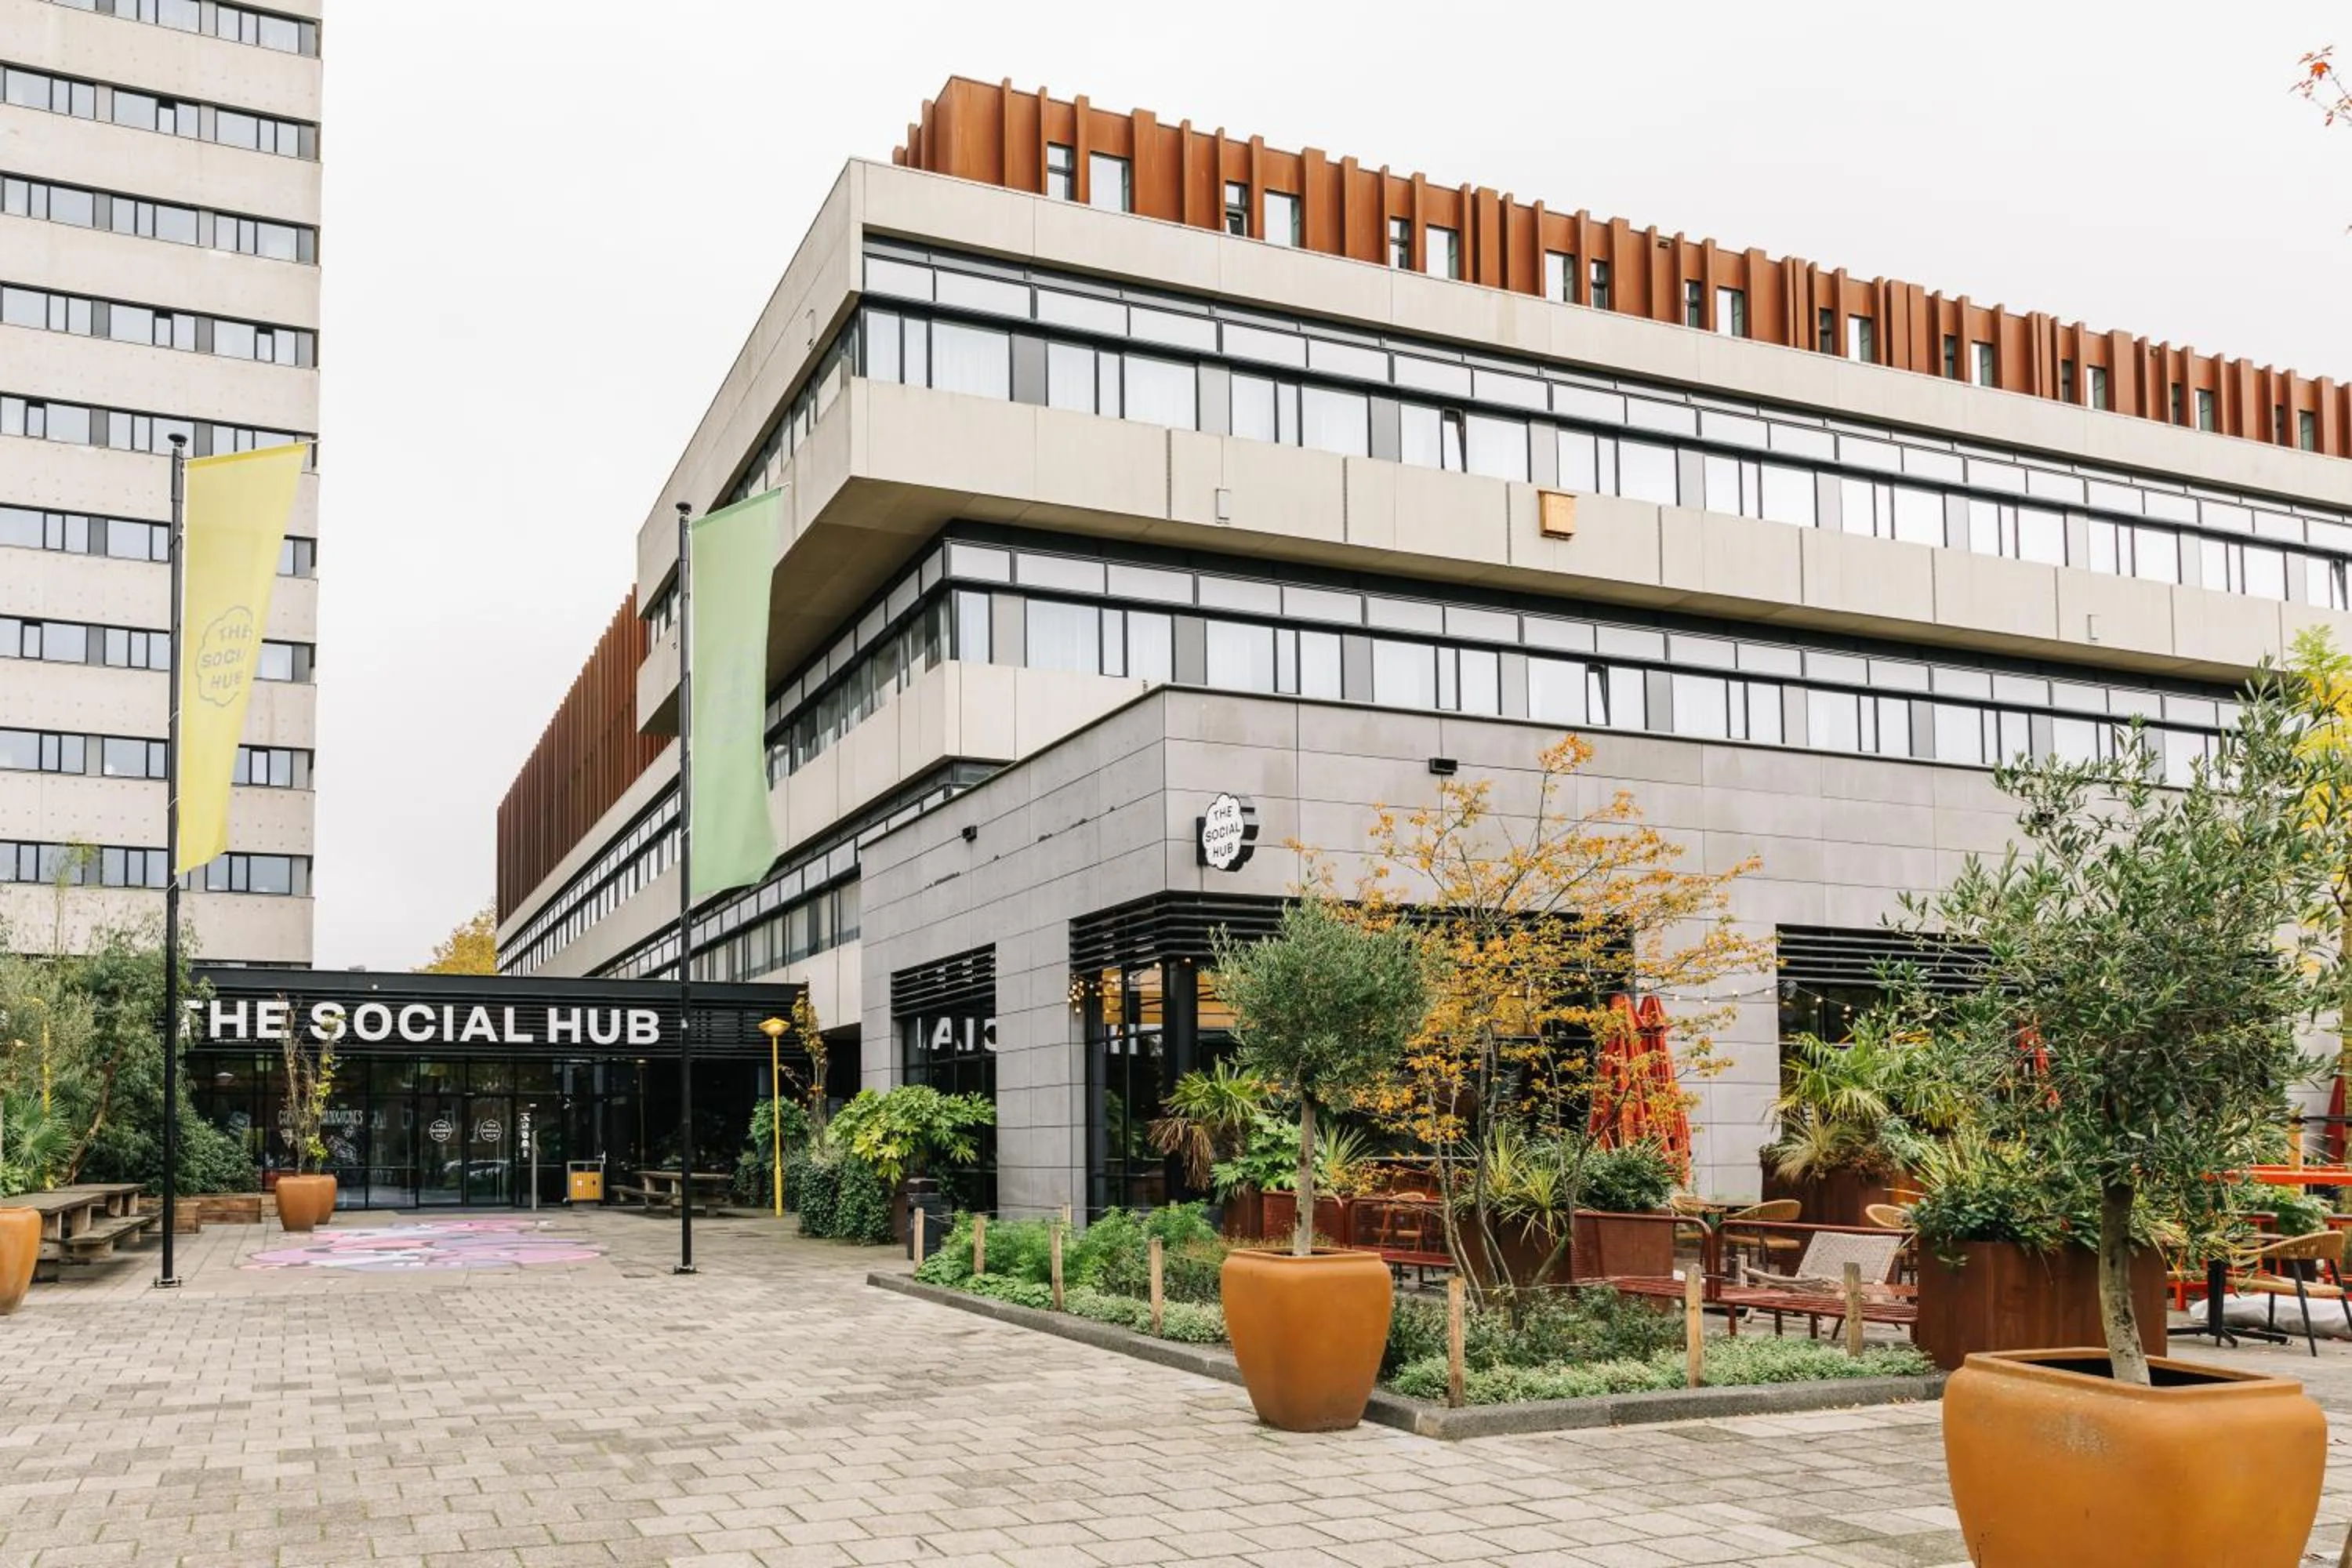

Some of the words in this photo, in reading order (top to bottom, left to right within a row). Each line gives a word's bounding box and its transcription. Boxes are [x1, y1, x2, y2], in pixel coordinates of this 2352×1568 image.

[1214, 806, 1232, 820] THE
[1206, 822, 1240, 843] SOCIAL
[1214, 843, 1233, 858] HUB
[310, 1001, 534, 1044] SOCIAL
[547, 1007, 661, 1045] HUB
